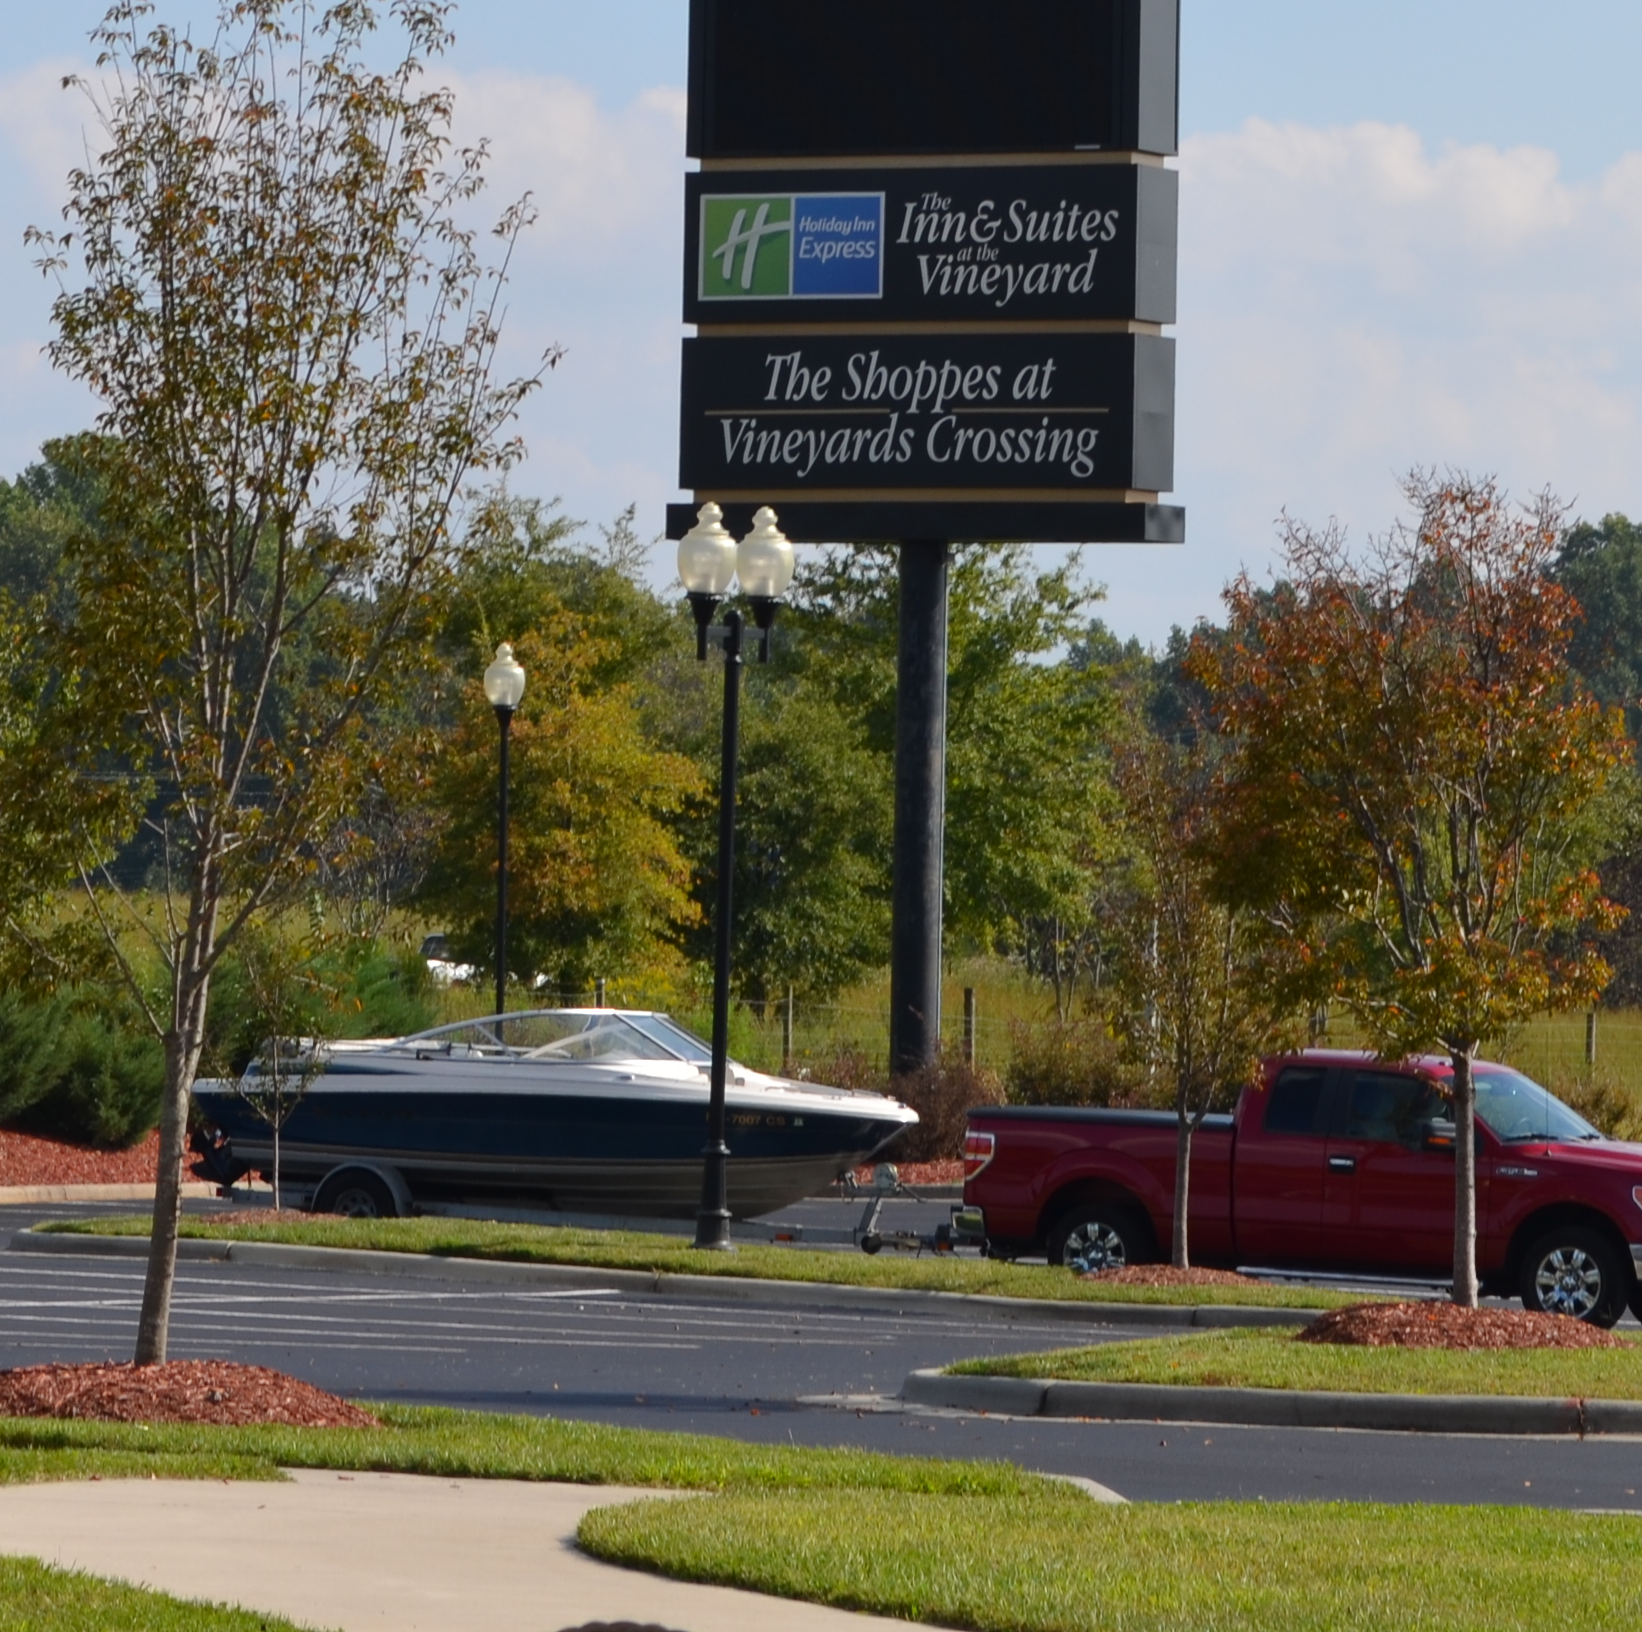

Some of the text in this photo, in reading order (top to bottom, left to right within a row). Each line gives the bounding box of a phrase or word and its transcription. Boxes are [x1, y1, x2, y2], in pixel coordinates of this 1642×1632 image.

[921, 191, 952, 211] The
[799, 215, 875, 236] Holiday Inn
[798, 236, 876, 265] Express
[956, 243, 999, 262] at the
[917, 247, 1099, 308] Vineyard
[764, 349, 1057, 414] The Shoppes at
[720, 411, 1099, 478] Vineyards Crossing
